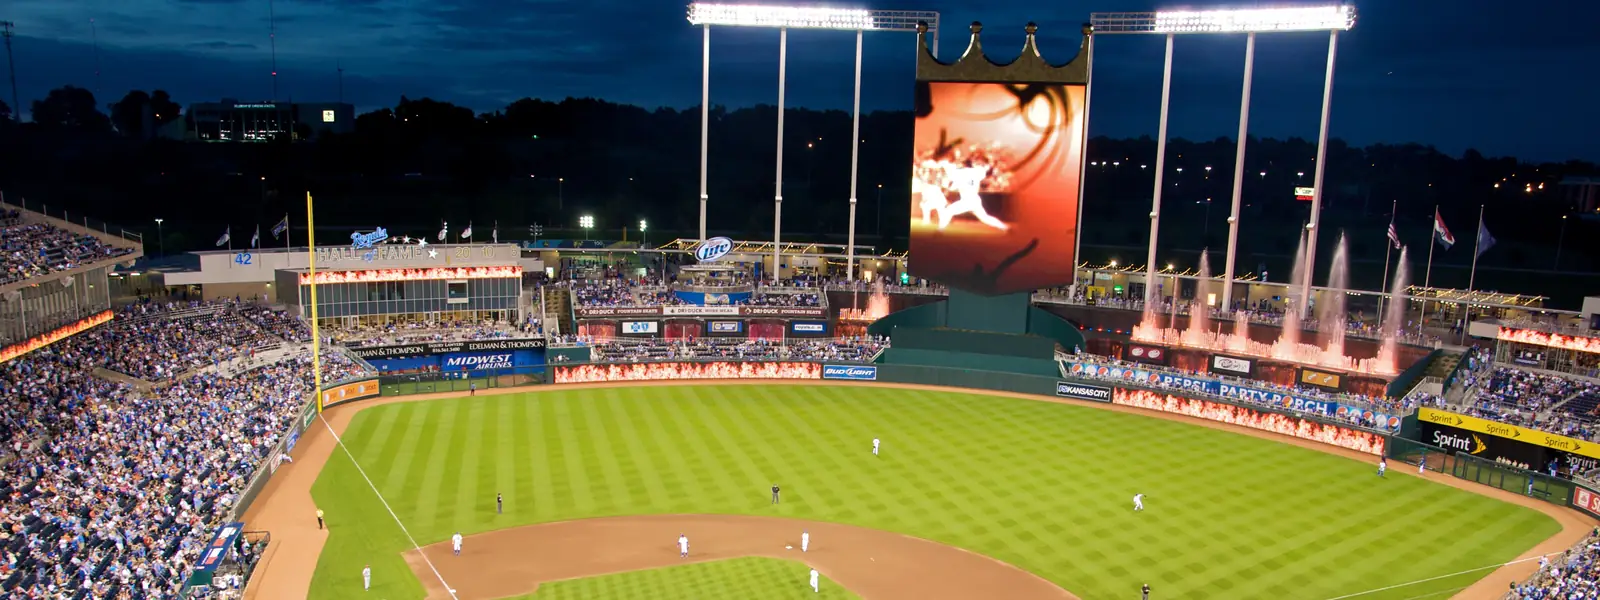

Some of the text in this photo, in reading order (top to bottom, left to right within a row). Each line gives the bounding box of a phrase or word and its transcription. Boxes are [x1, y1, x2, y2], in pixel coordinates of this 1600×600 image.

[351, 226, 388, 249] Royals
[317, 246, 423, 264] HALL of FAME
[456, 246, 471, 259] 20
[481, 246, 494, 258] 10
[703, 243, 728, 260] Lite
[235, 252, 252, 265] 42
[378, 347, 385, 356] &
[386, 346, 424, 355] THOMPSON
[469, 340, 544, 350] EDELMAN & THOMPSON
[447, 353, 512, 366] MIDWEST
[475, 362, 512, 370] AIRLINES
[848, 368, 874, 376] LIGHT
[1068, 385, 1094, 397] KANSAS
[1094, 389, 1109, 398] CITY
[1219, 385, 1268, 403] PARTY
[1430, 412, 1452, 425] Sprint
[1486, 423, 1509, 436] Sprint
[1432, 430, 1470, 451] Sprint
[1545, 436, 1569, 449] Sprint
[1566, 452, 1598, 468] Sprint
